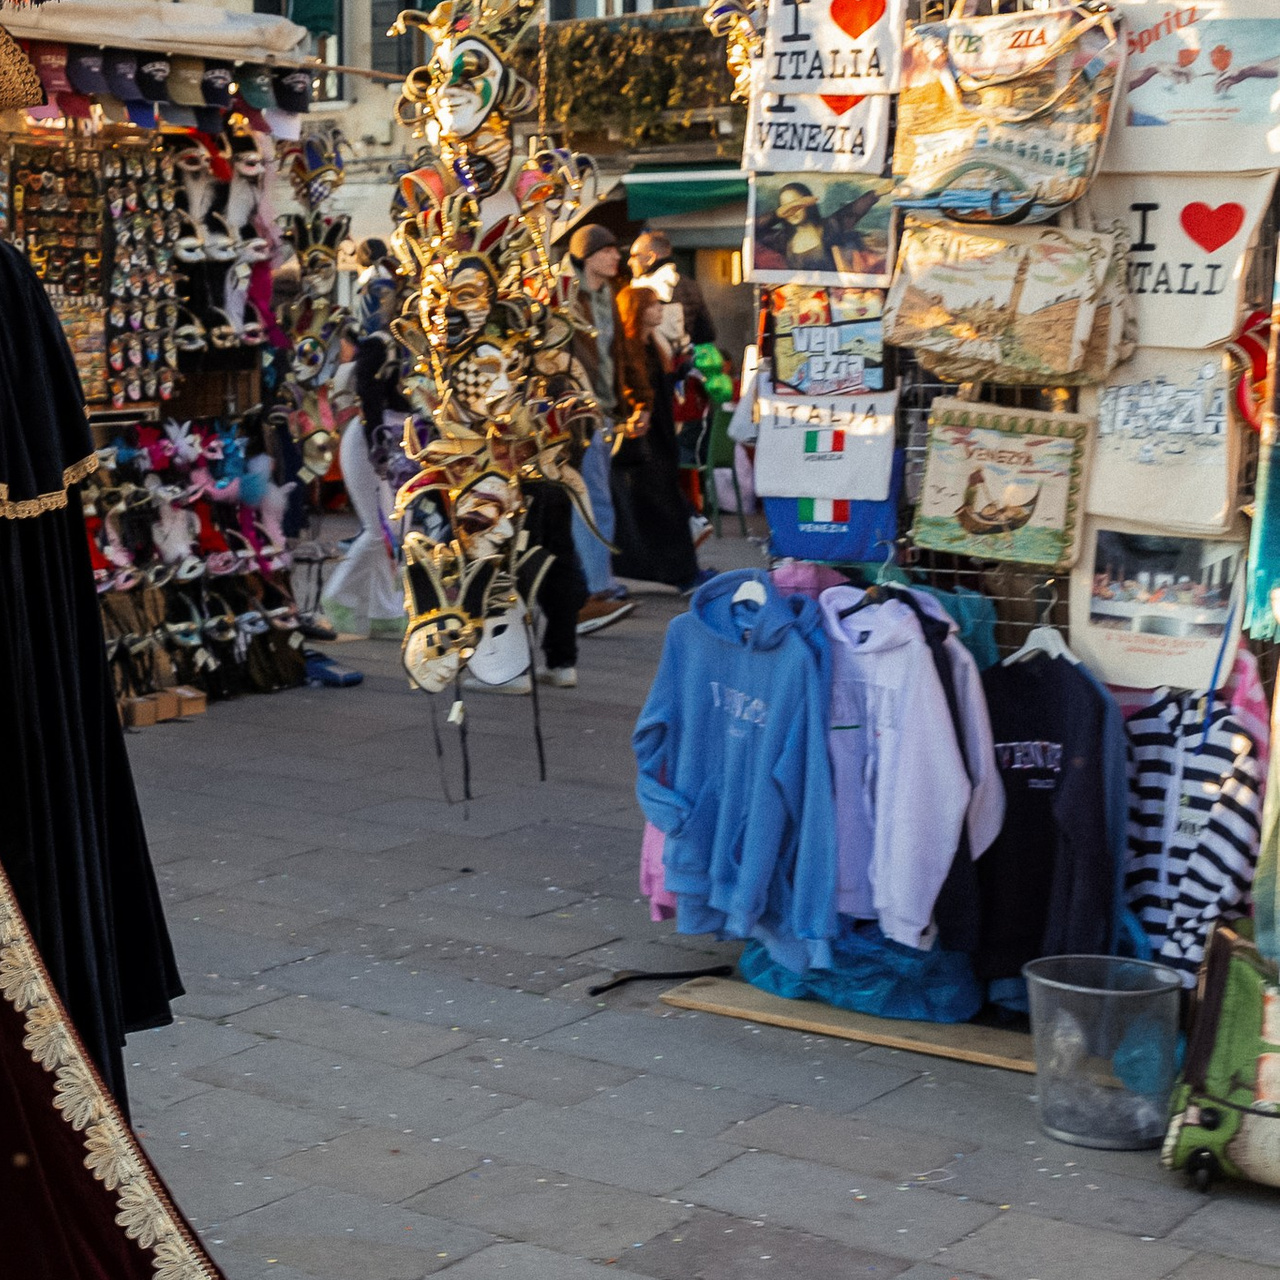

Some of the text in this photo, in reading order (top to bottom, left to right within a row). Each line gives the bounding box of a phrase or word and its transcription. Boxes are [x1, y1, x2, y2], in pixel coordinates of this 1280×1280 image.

[772, 48, 884, 81] ITALIA
[757, 121, 865, 156] VENEZIA
[1130, 203, 1159, 252] I
